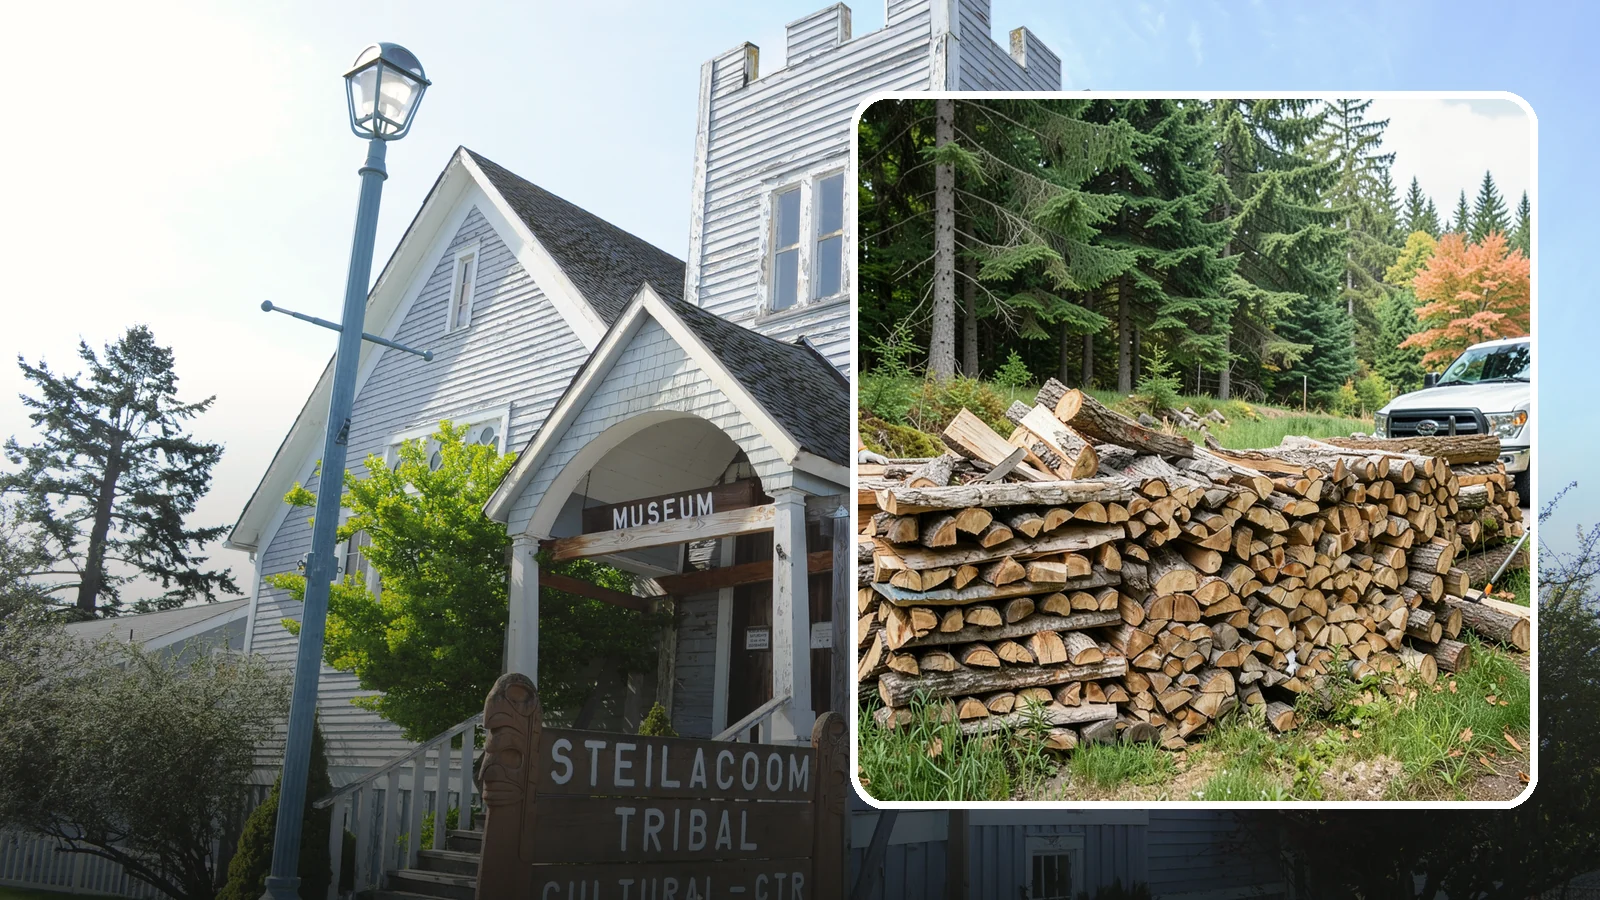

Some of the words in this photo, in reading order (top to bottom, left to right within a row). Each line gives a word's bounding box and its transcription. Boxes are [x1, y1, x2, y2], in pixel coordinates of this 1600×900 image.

[613, 491, 713, 530] MUSEUM
[551, 738, 809, 792] STEILACOOM
[615, 807, 757, 852] TRIBAL
